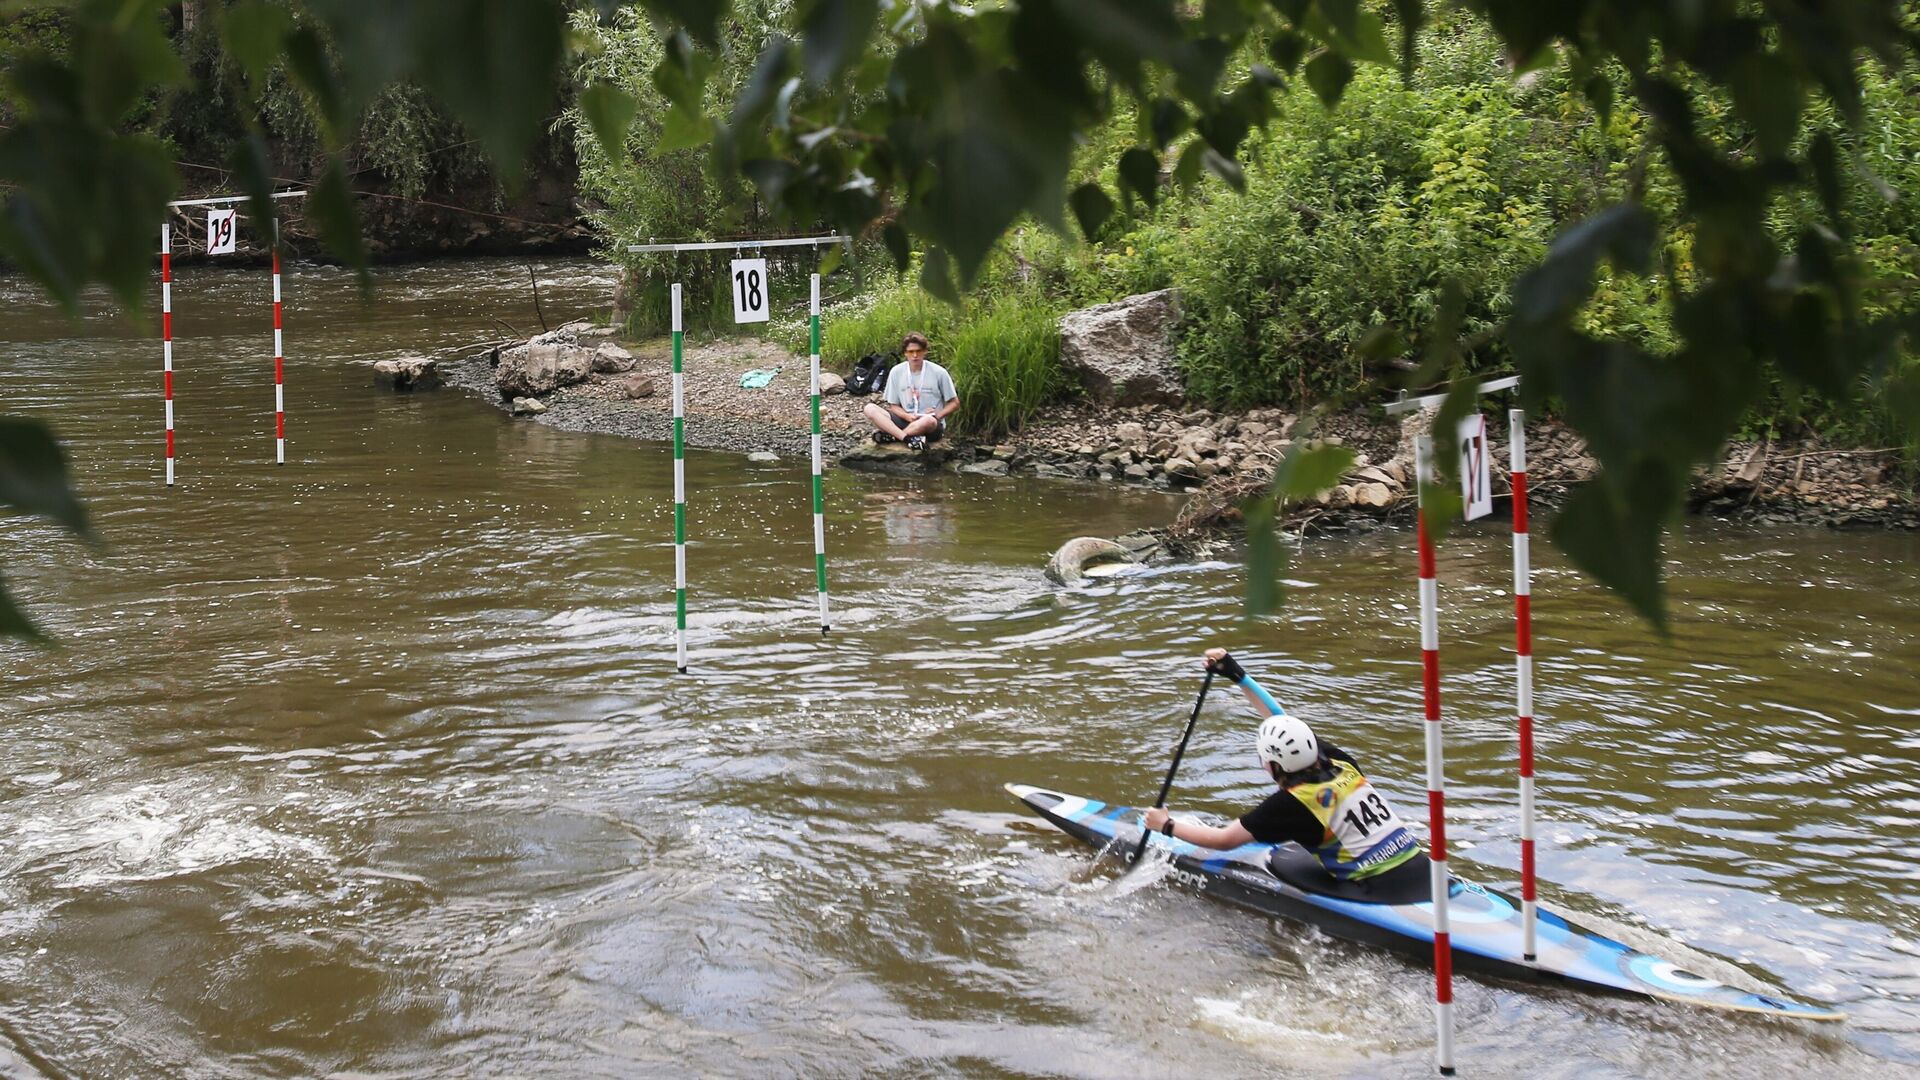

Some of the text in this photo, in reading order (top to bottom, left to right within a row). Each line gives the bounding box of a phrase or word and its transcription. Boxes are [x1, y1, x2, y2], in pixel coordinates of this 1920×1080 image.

[211, 217, 231, 247] 19
[735, 269, 762, 312] 18
[1462, 436, 1482, 504] 17
[1343, 793, 1391, 837] 143
